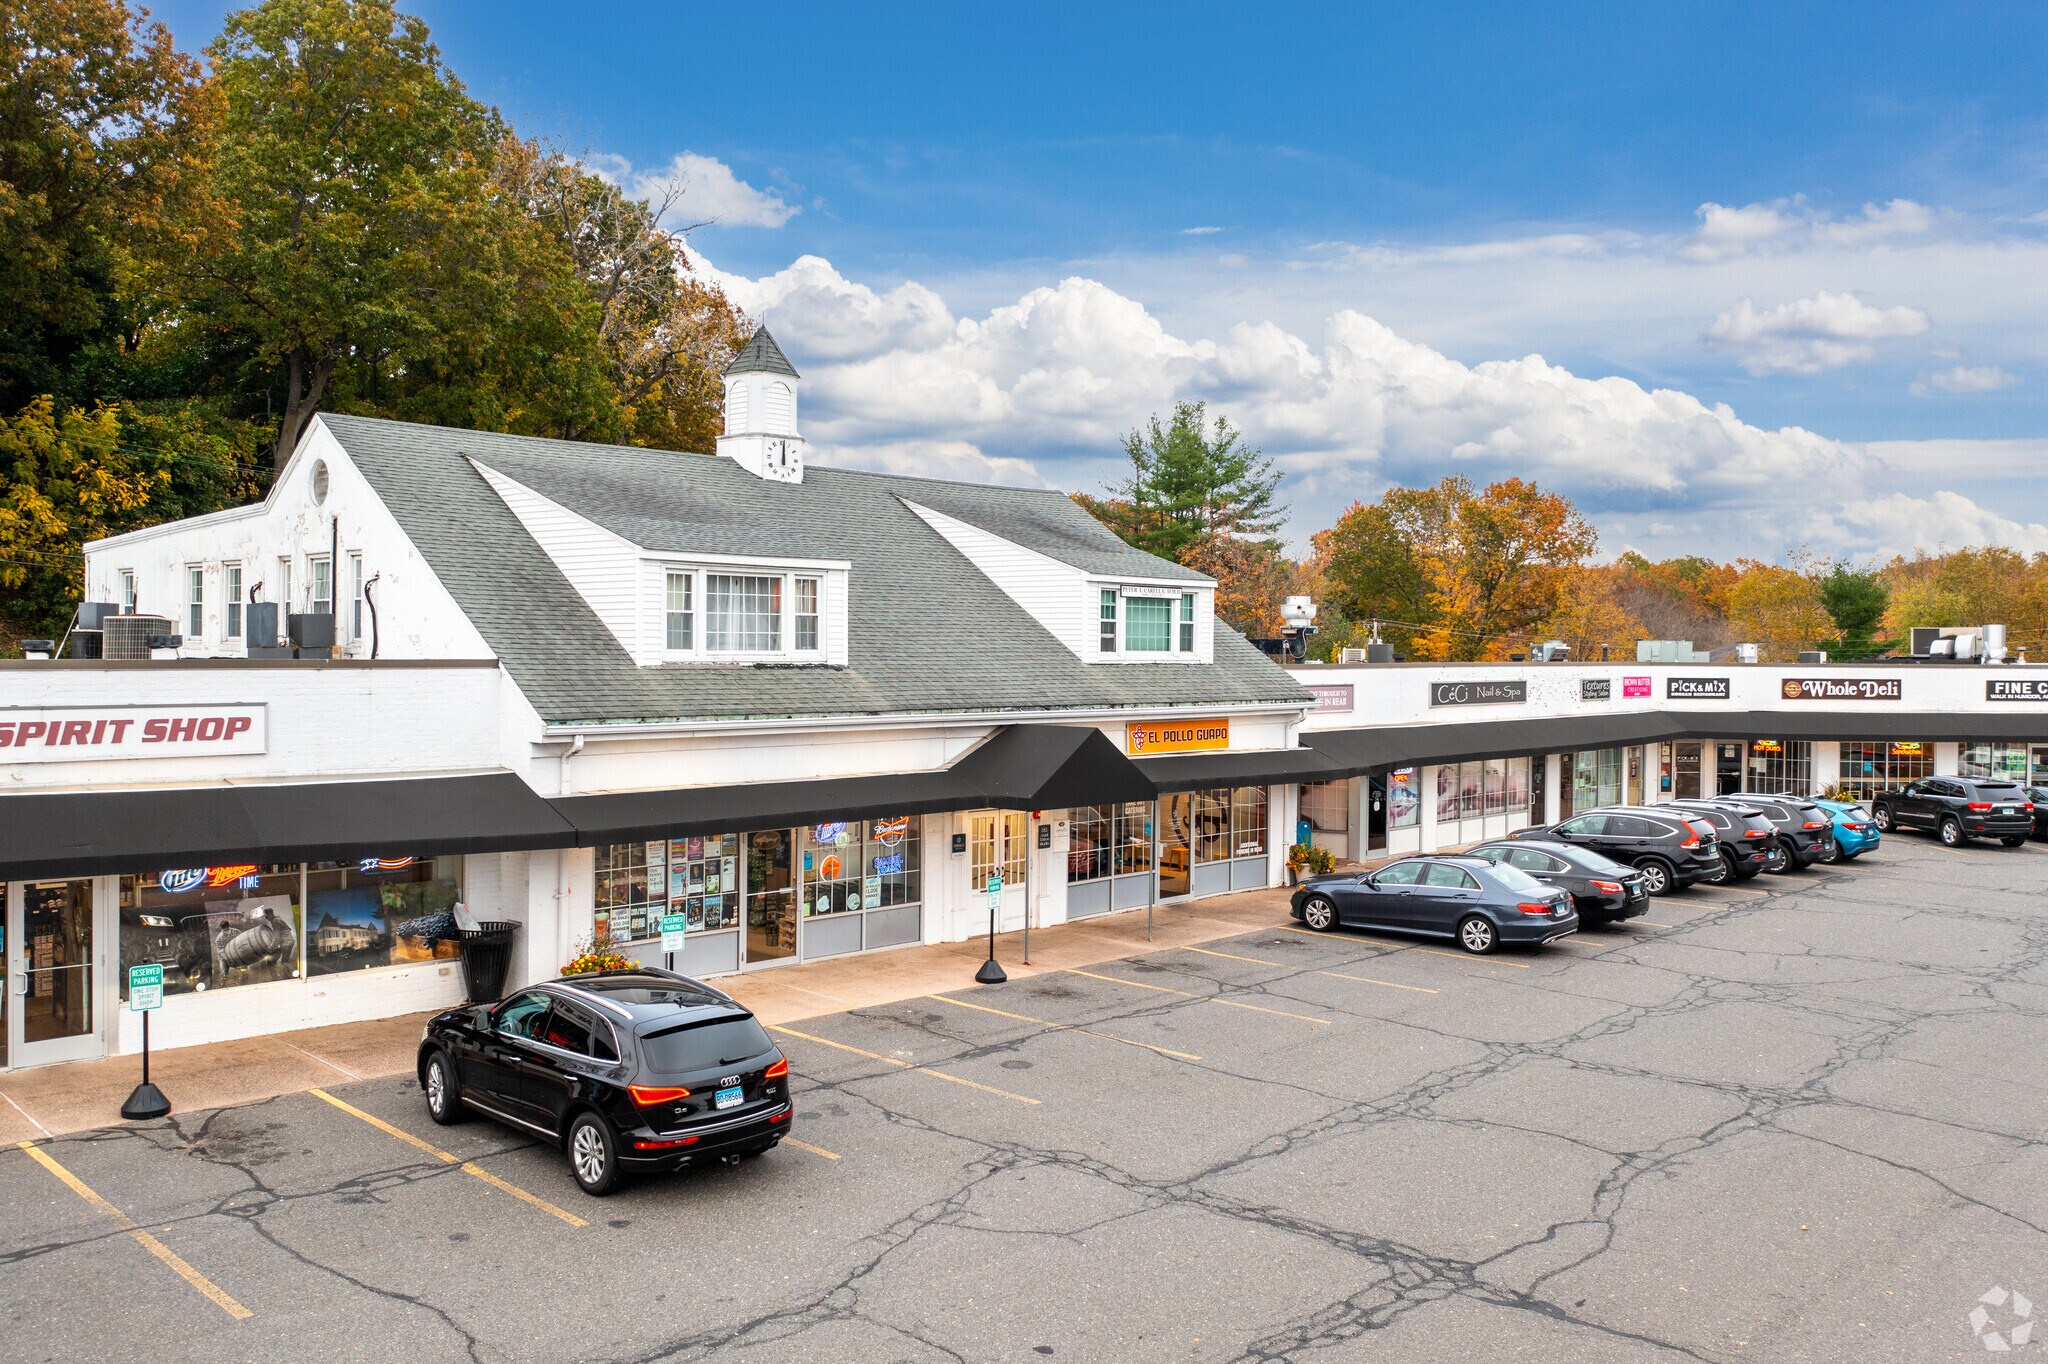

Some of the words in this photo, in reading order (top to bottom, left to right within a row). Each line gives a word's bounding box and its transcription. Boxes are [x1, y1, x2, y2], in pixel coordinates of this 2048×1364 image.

[1583, 680, 1610, 691] Textures
[1624, 678, 1638, 686] BROWN
[1638, 678, 1651, 686] BUTTER
[1597, 689, 1609, 697] Salon
[1802, 681, 1857, 697] Whole
[1859, 681, 1899, 698] Deli
[1994, 682, 2032, 694] FINE
[1437, 684, 1469, 703] CéCi
[1476, 685, 1494, 699] Nail
[1494, 688, 1502, 697] &
[1502, 685, 1521, 700] Spa
[1324, 697, 1332, 706] IN
[1332, 697, 1347, 706] REAR
[142, 716, 252, 743] SHOP
[1148, 731, 1160, 743] EL
[1163, 729, 1193, 743] POLLO
[1196, 727, 1228, 740] GUAPO
[1125, 806, 1146, 815] CATERING
[239, 875, 259, 889] TIME
[663, 916, 683, 924] RESERVED
[664, 923, 682, 931] PARKING
[132, 967, 161, 977] RESERVED
[133, 976, 159, 986] PARKING
